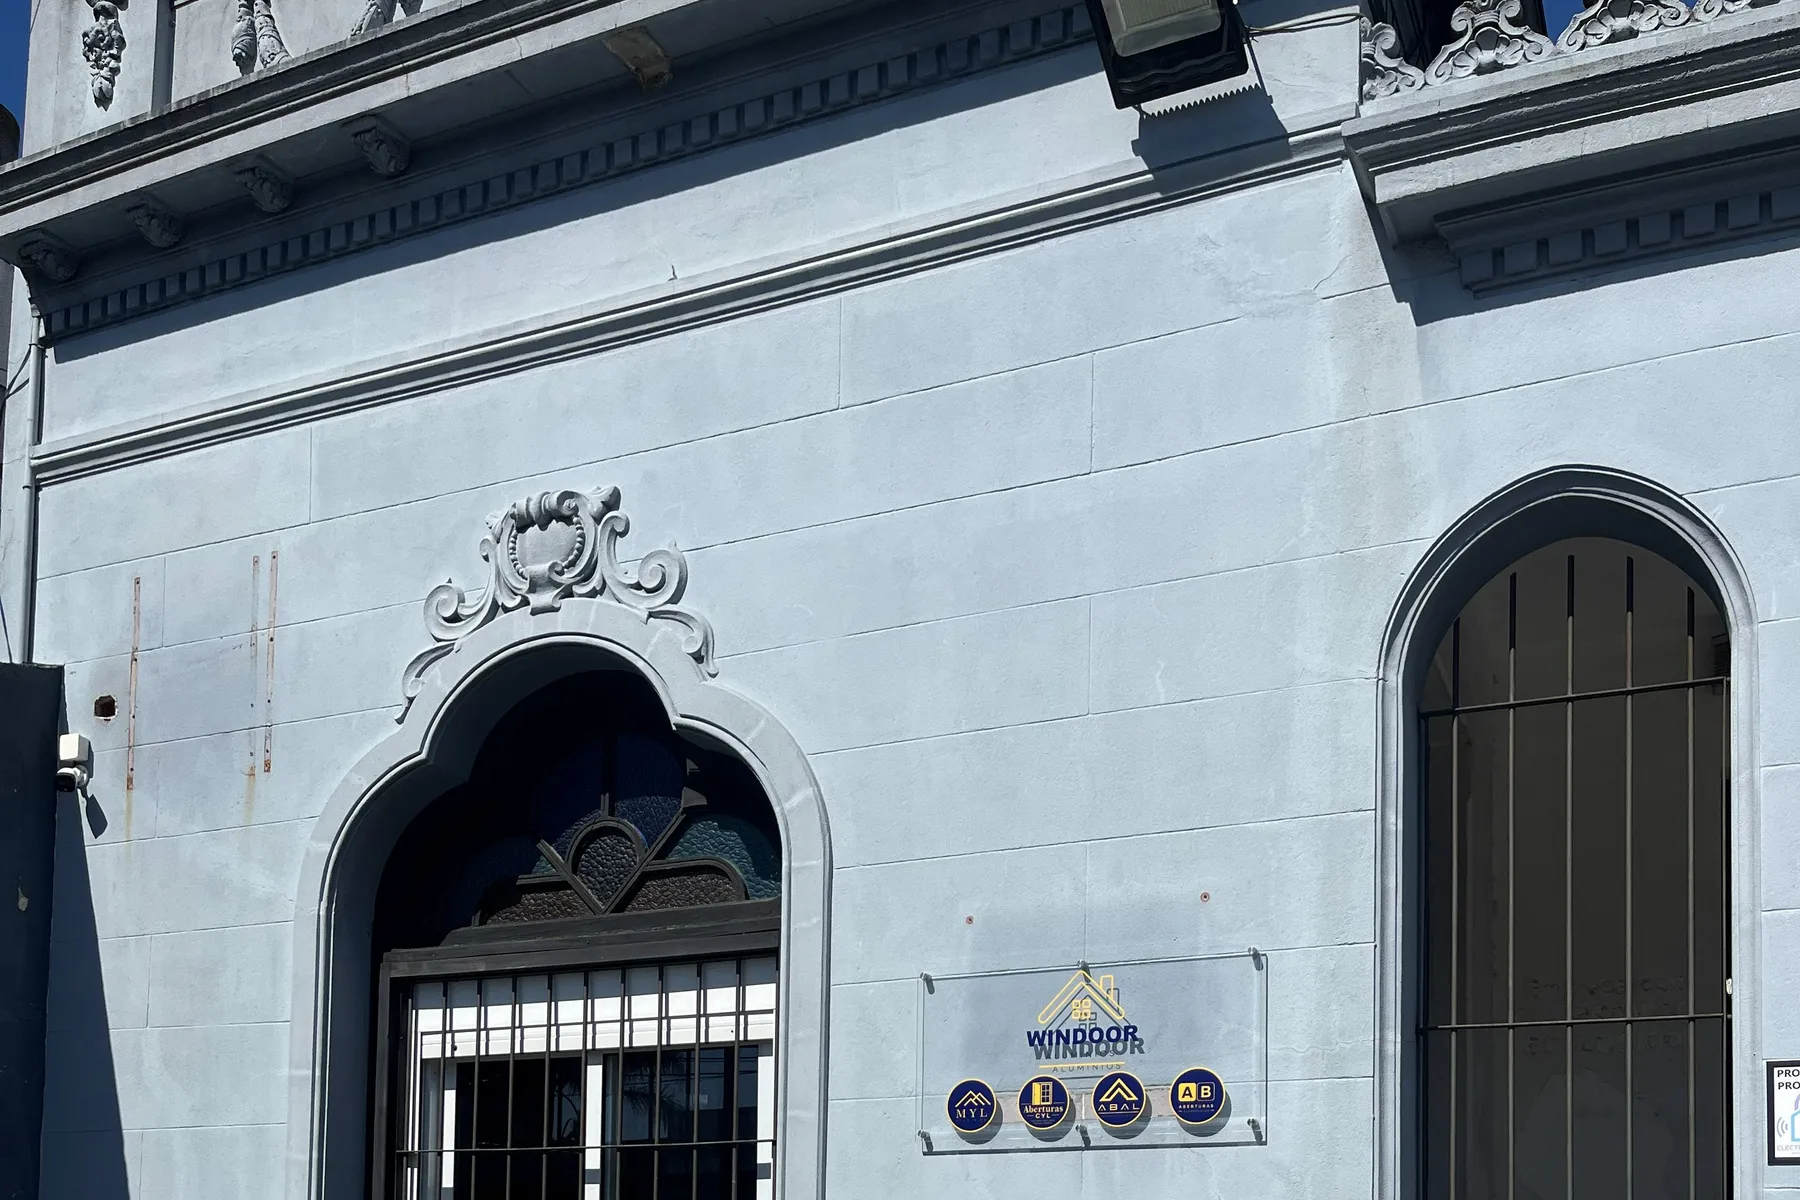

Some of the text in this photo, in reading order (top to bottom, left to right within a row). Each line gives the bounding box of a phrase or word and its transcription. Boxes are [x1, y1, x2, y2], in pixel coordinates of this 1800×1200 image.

[1027, 1025, 1139, 1047] WINDOOR
[1024, 1104, 1064, 1114] Aberturas
[1097, 1103, 1140, 1111] ABAL
[955, 1108, 988, 1118] MYL
